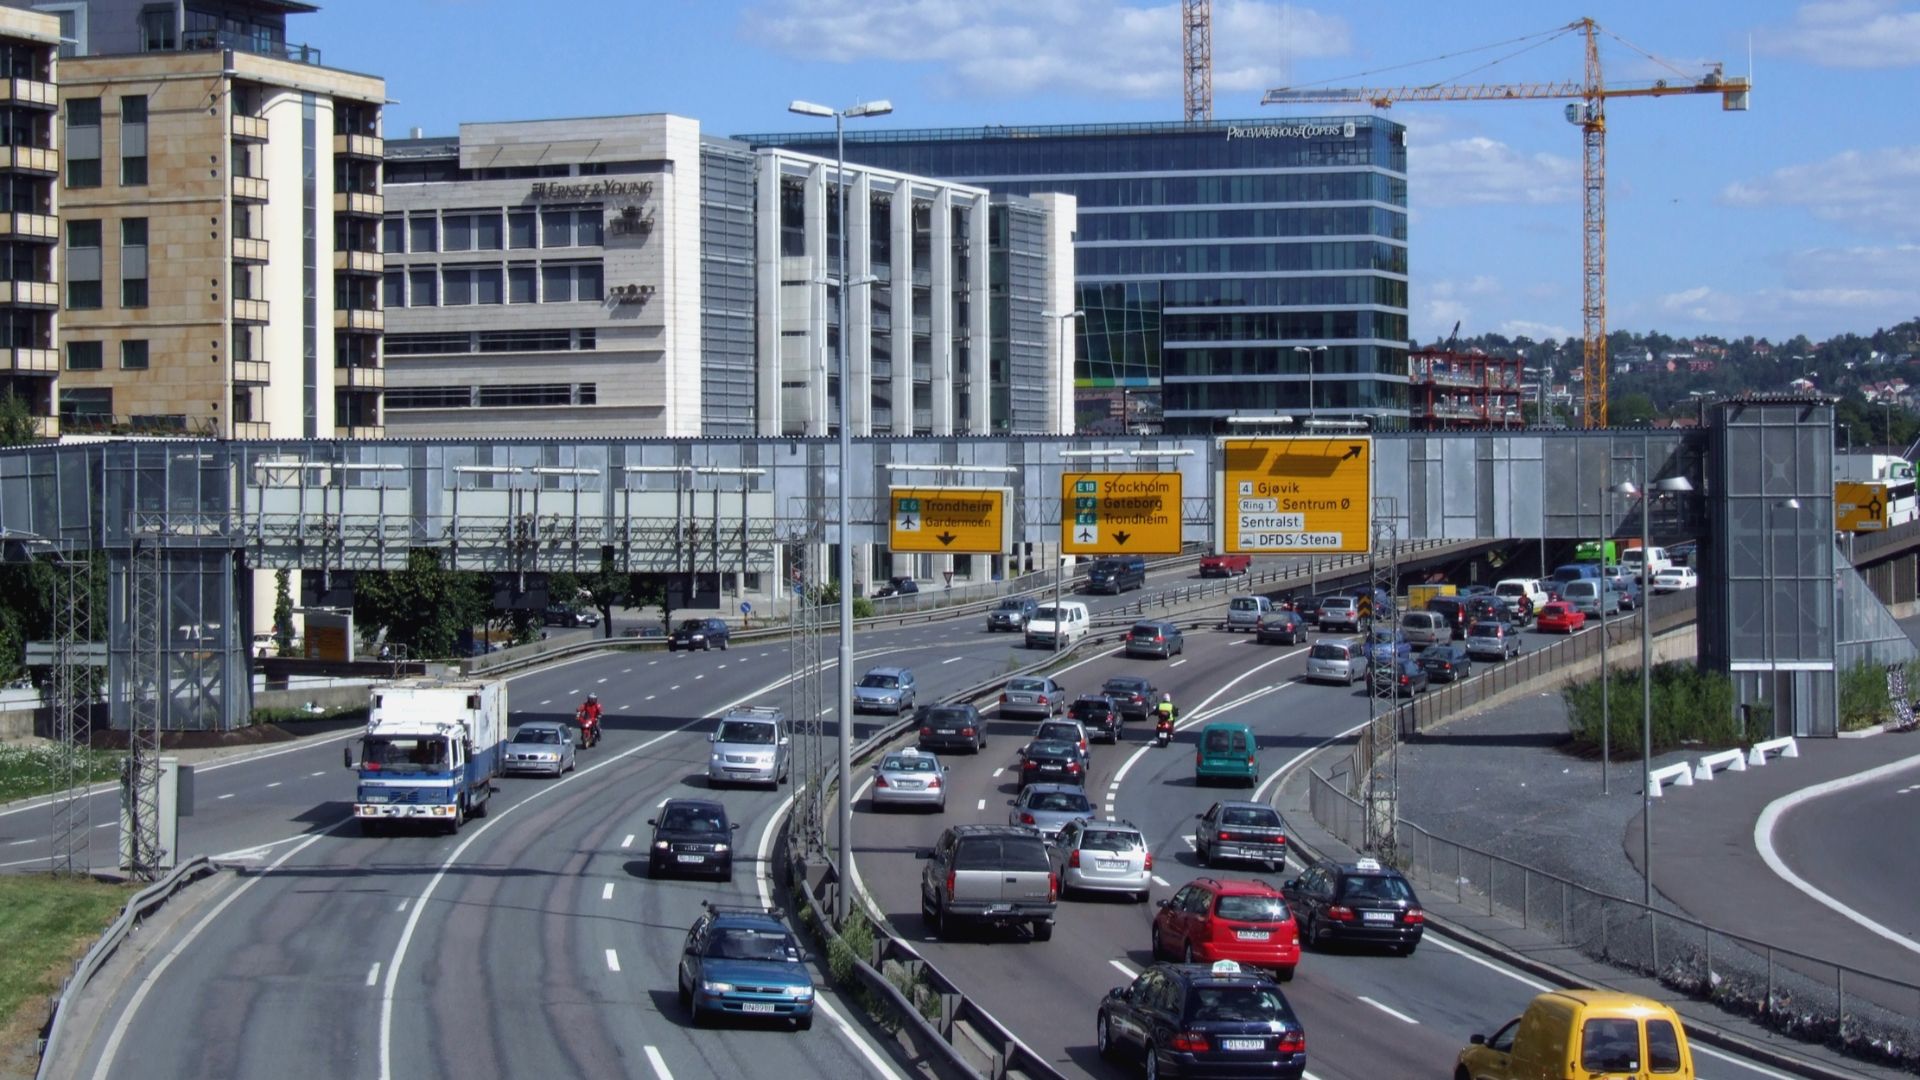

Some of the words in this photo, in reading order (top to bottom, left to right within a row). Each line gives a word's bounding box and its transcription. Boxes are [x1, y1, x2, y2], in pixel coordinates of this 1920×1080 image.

[1104, 481, 1169, 492] Stockholm
[1243, 484, 1249, 492] 4
[1258, 482, 1300, 496] Gjøvik
[925, 500, 993, 512] Trondheim
[1243, 501, 1264, 511] Ring
[1282, 499, 1337, 510] Sentrum
[925, 517, 991, 527] Gardermoen
[1104, 513, 1168, 524] Trondheim
[1259, 533, 1337, 546] DFDS/Stena
